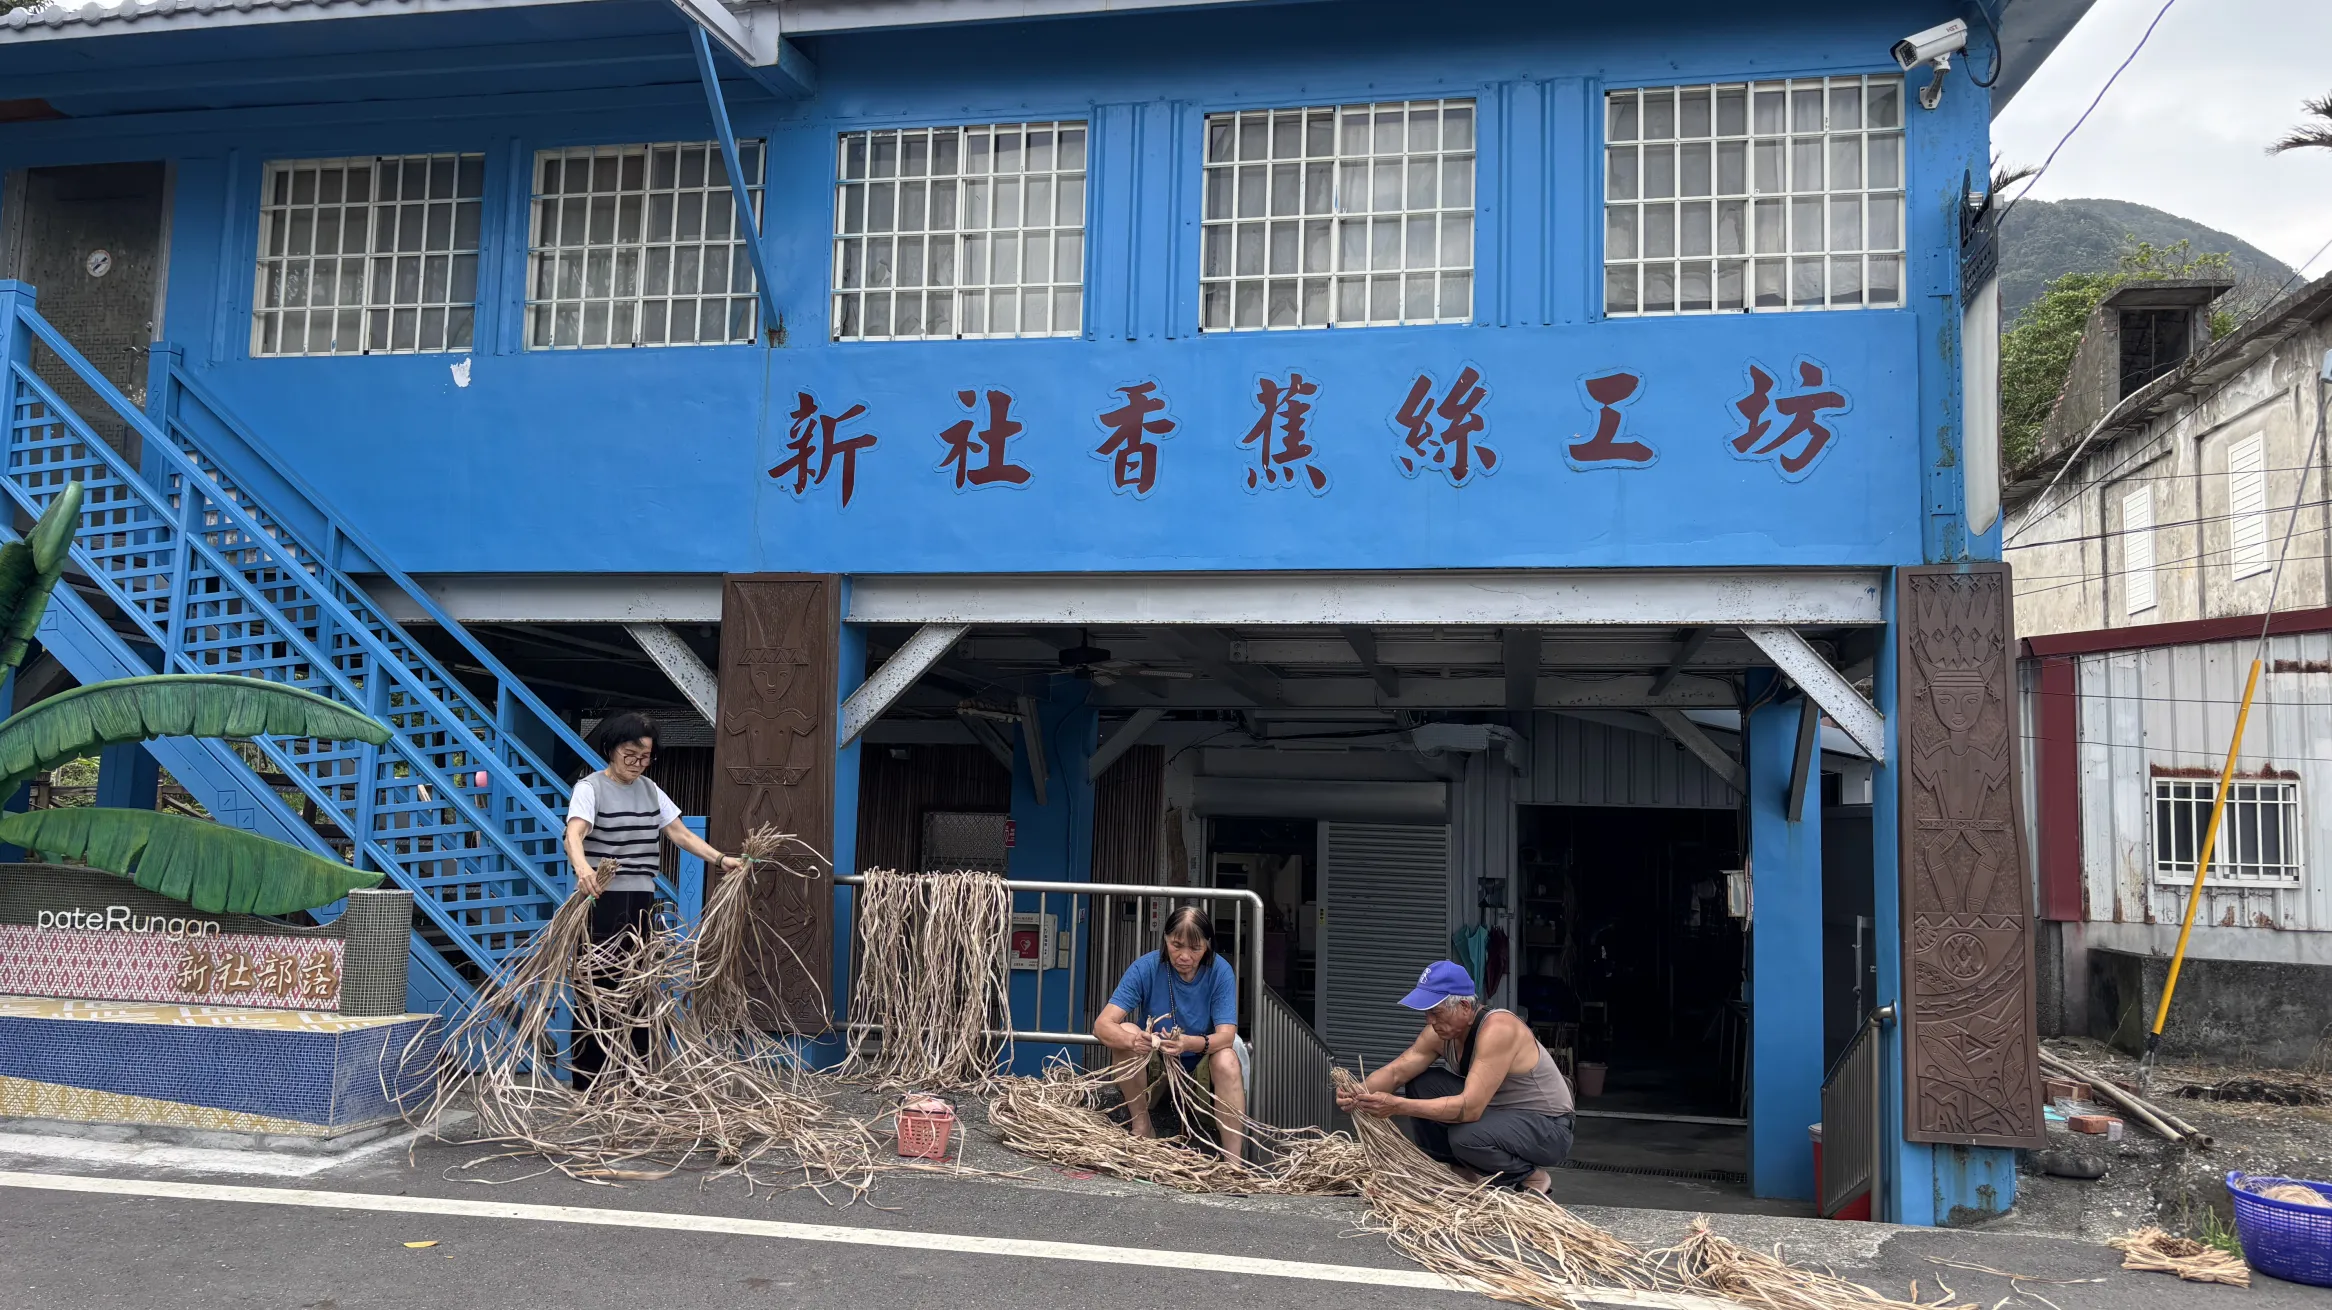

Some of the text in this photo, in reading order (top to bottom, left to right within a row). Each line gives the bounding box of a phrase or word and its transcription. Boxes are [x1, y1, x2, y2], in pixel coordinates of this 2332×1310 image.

[768, 361, 1846, 508] 新社香蕉絲工坊
[37, 905, 220, 941] pateRungan
[176, 950, 336, 997] 新社部落
